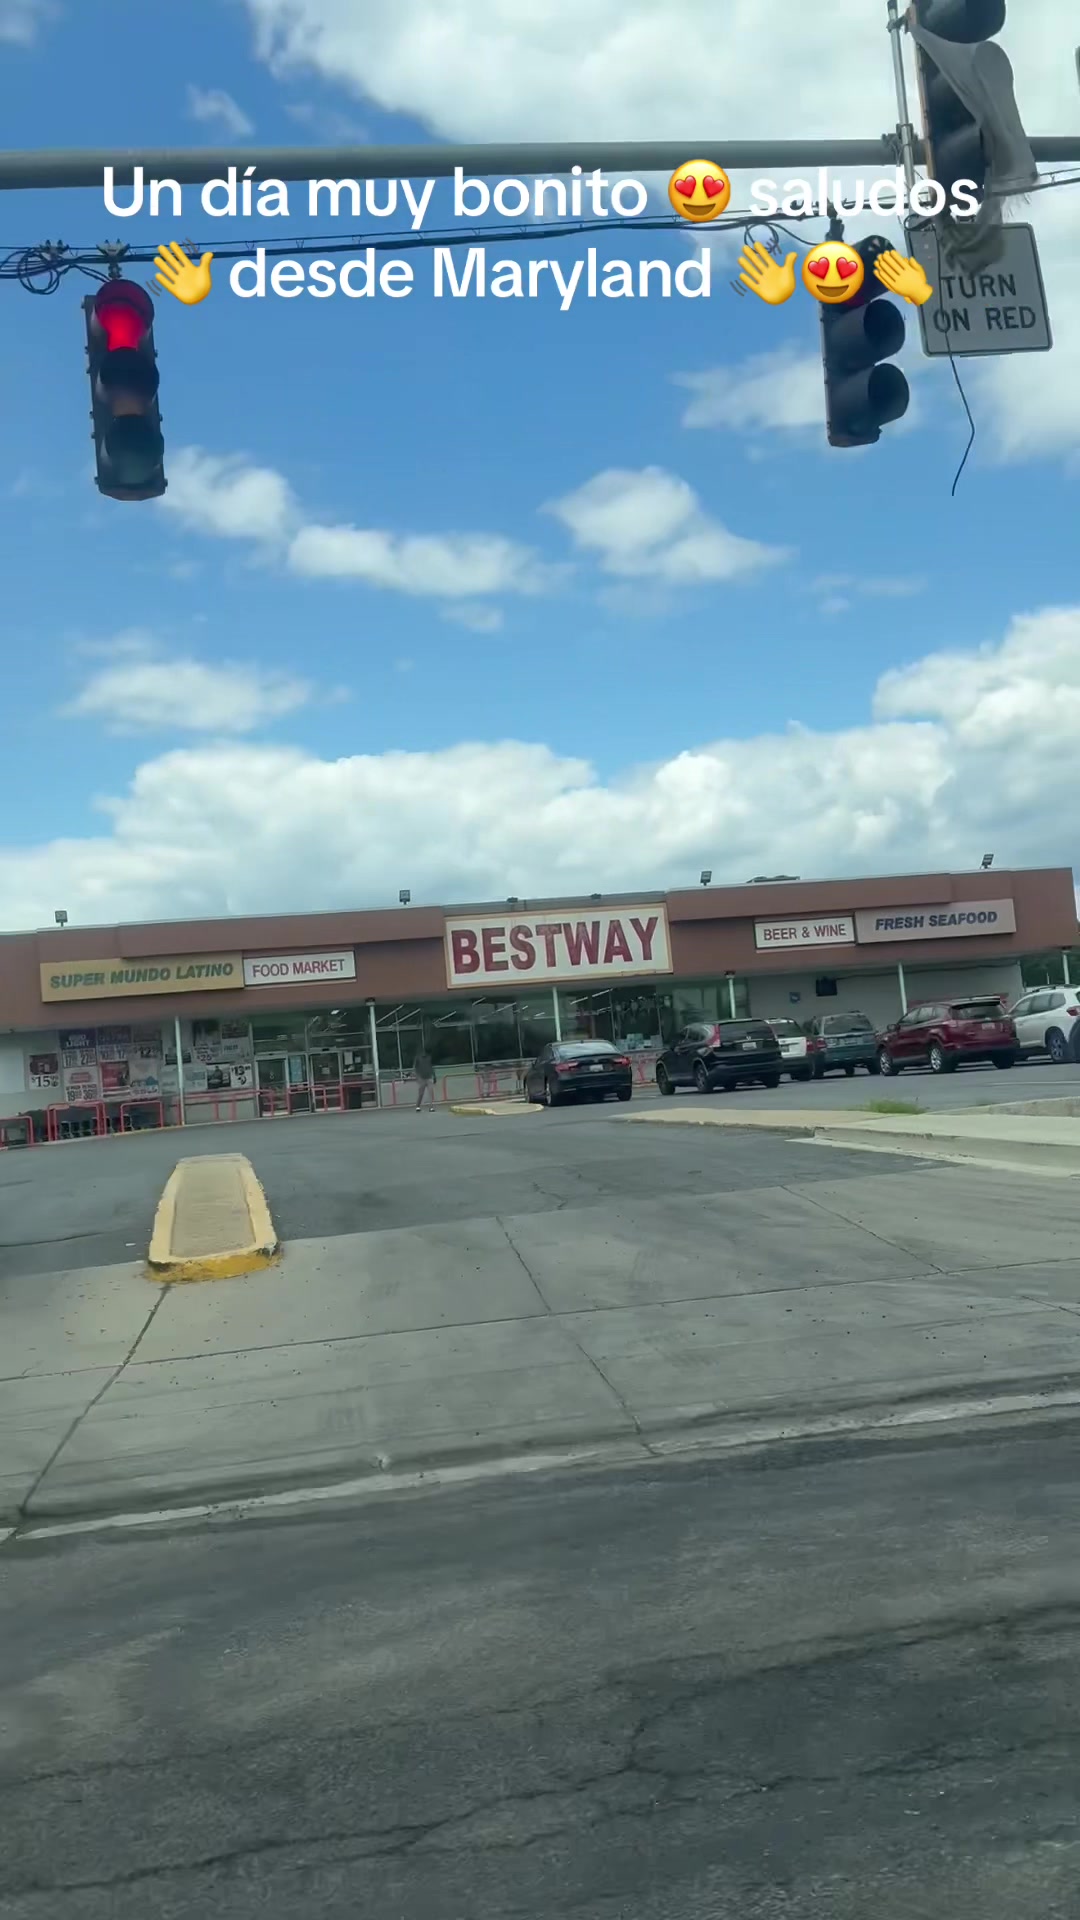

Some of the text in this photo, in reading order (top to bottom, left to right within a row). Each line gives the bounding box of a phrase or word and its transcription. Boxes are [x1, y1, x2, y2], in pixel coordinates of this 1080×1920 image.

[941, 274, 1017, 299] TURN
[933, 306, 1036, 333] ON RED
[763, 924, 847, 941] BEER & WINE
[875, 911, 998, 931] FRESH SEAFOOD
[451, 916, 659, 975] BESTWAY
[50, 962, 234, 989] SUPER MUNDO LATINO
[252, 958, 345, 978] FOOD MARKET
